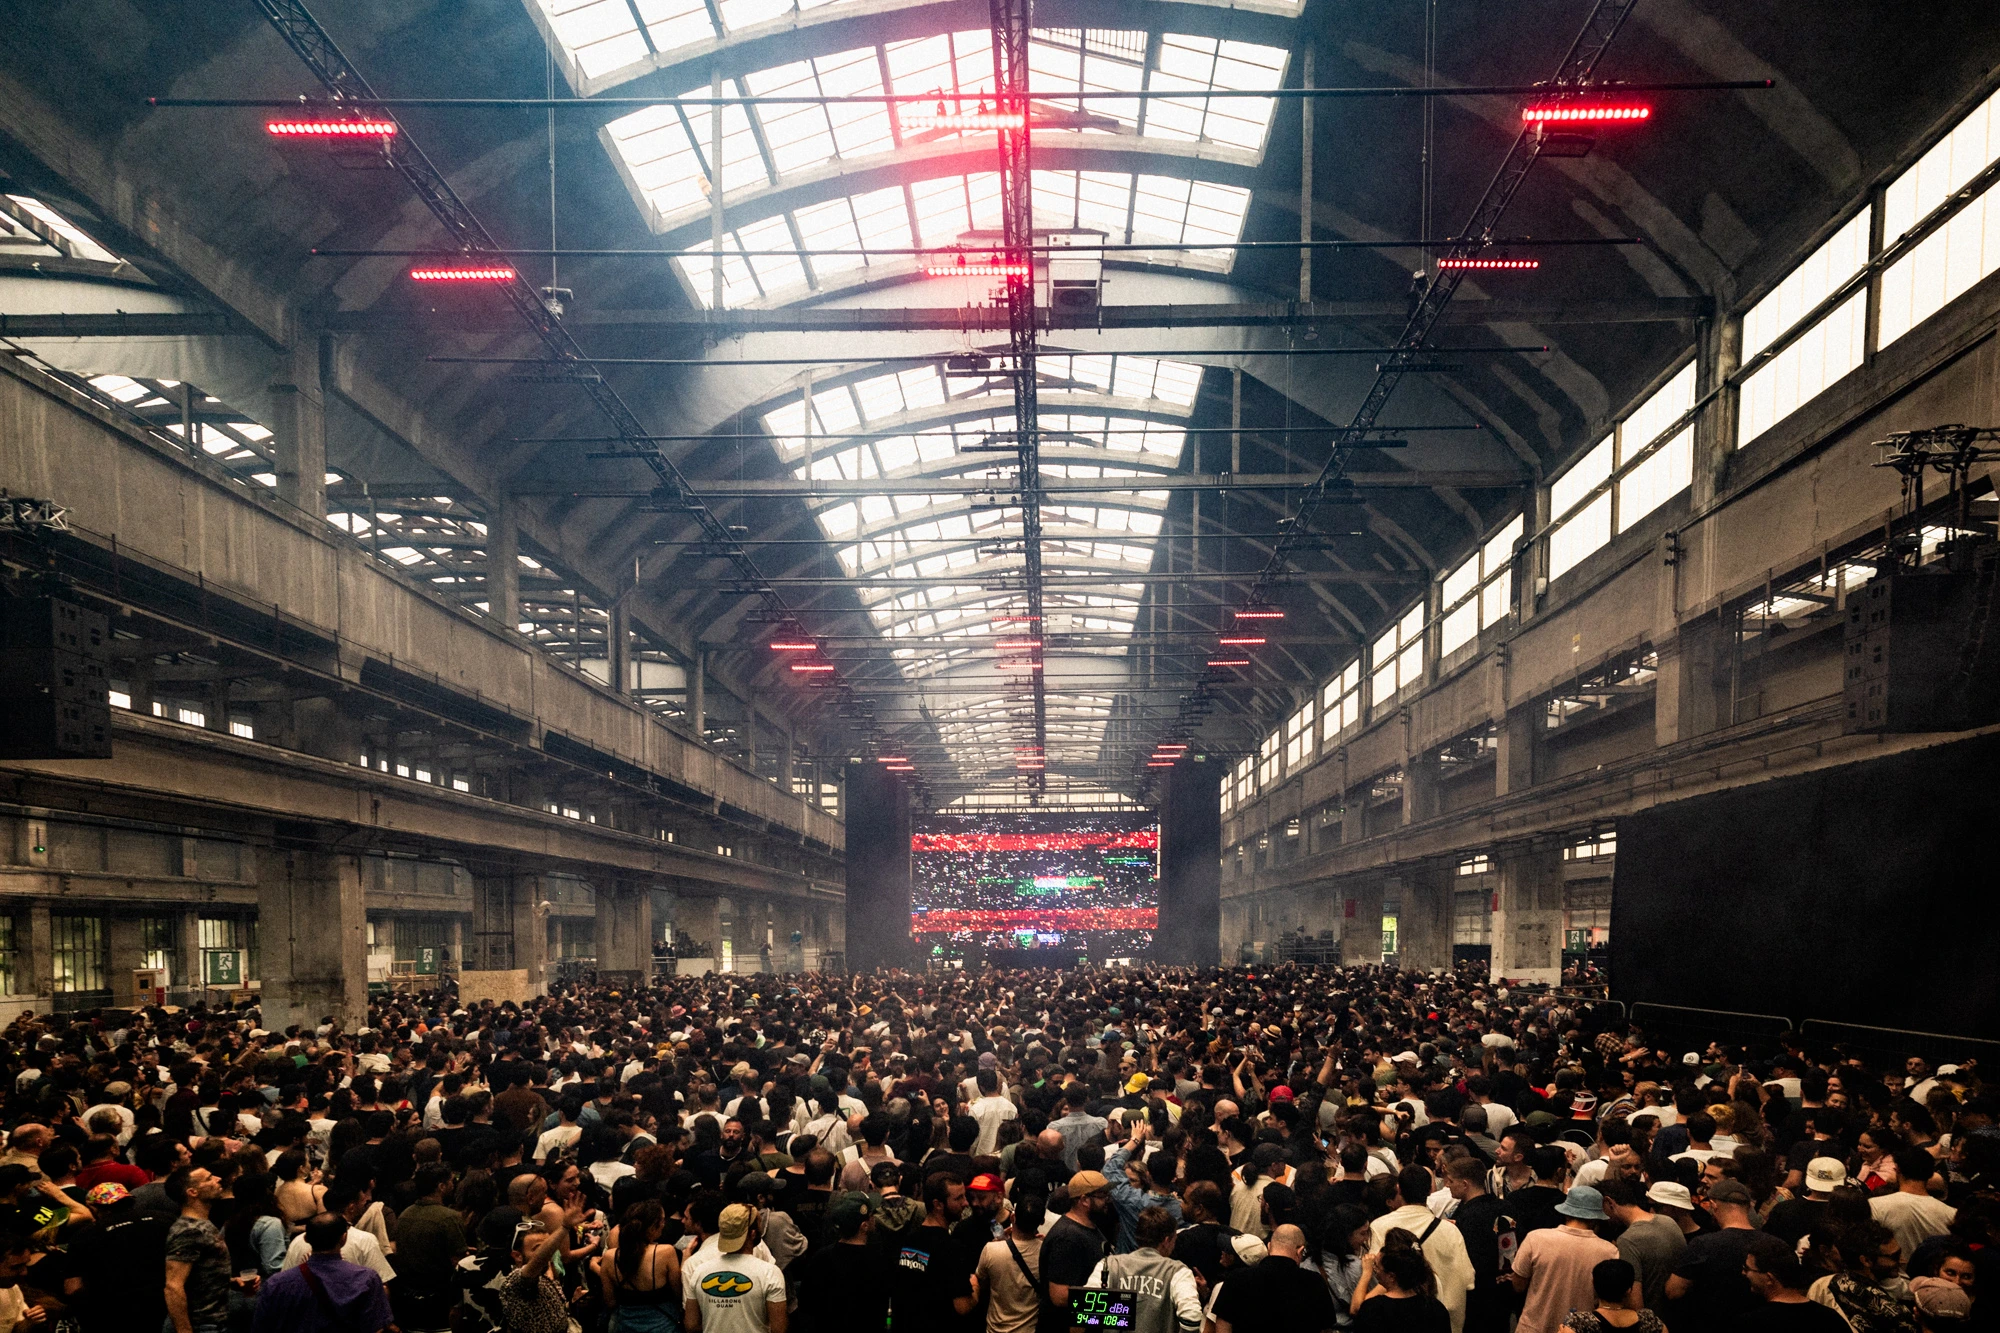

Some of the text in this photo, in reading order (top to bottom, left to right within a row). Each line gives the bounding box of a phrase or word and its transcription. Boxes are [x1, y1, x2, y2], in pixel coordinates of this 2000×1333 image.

[1120, 1275, 1163, 1299] NIKE
[1084, 1292, 1108, 1312] 95
[1109, 1303, 1129, 1314] dBA
[1077, 1314, 1088, 1324] 94
[1103, 1315, 1118, 1326] 108
